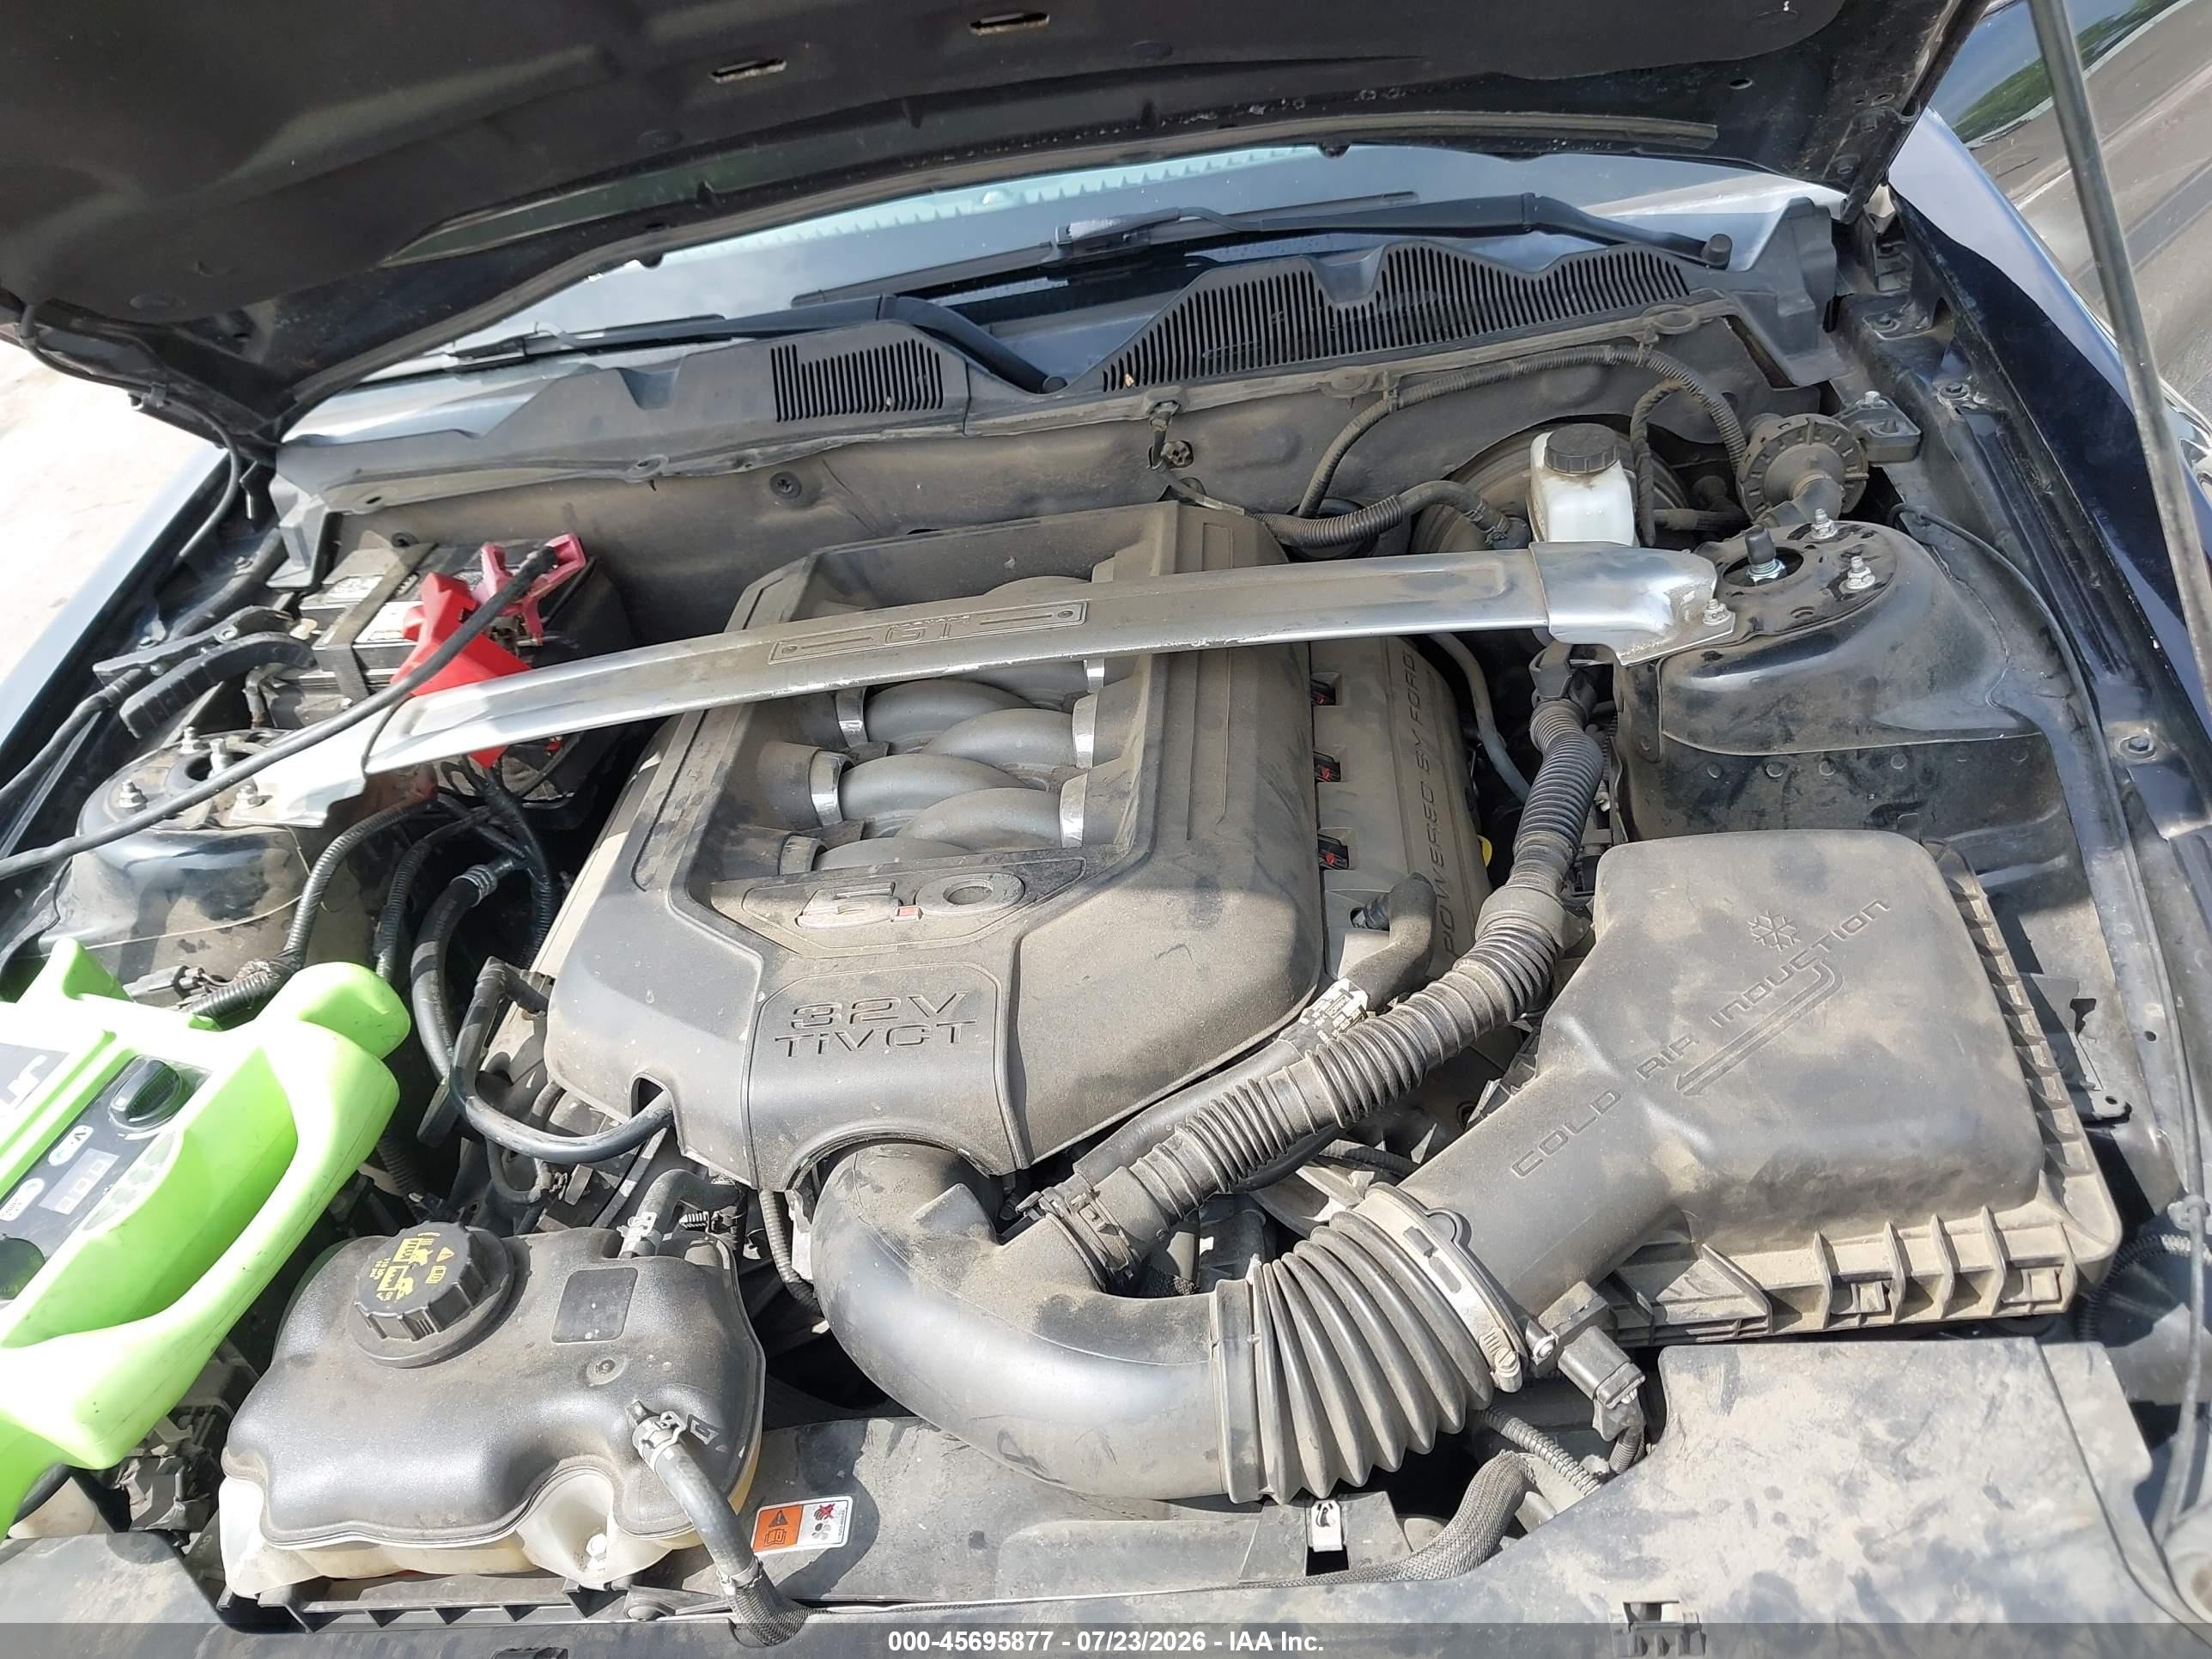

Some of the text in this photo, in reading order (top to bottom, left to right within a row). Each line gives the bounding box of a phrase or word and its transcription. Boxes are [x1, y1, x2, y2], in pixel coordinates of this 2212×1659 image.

[884, 616, 971, 645] GT
[1402, 652, 1458, 957] POWERED BY FORD
[795, 872, 1024, 927] 5.0
[791, 991, 969, 1030] 32V
[1511, 1090, 1621, 1178] COLD
[1635, 1033, 1700, 1080] AIR
